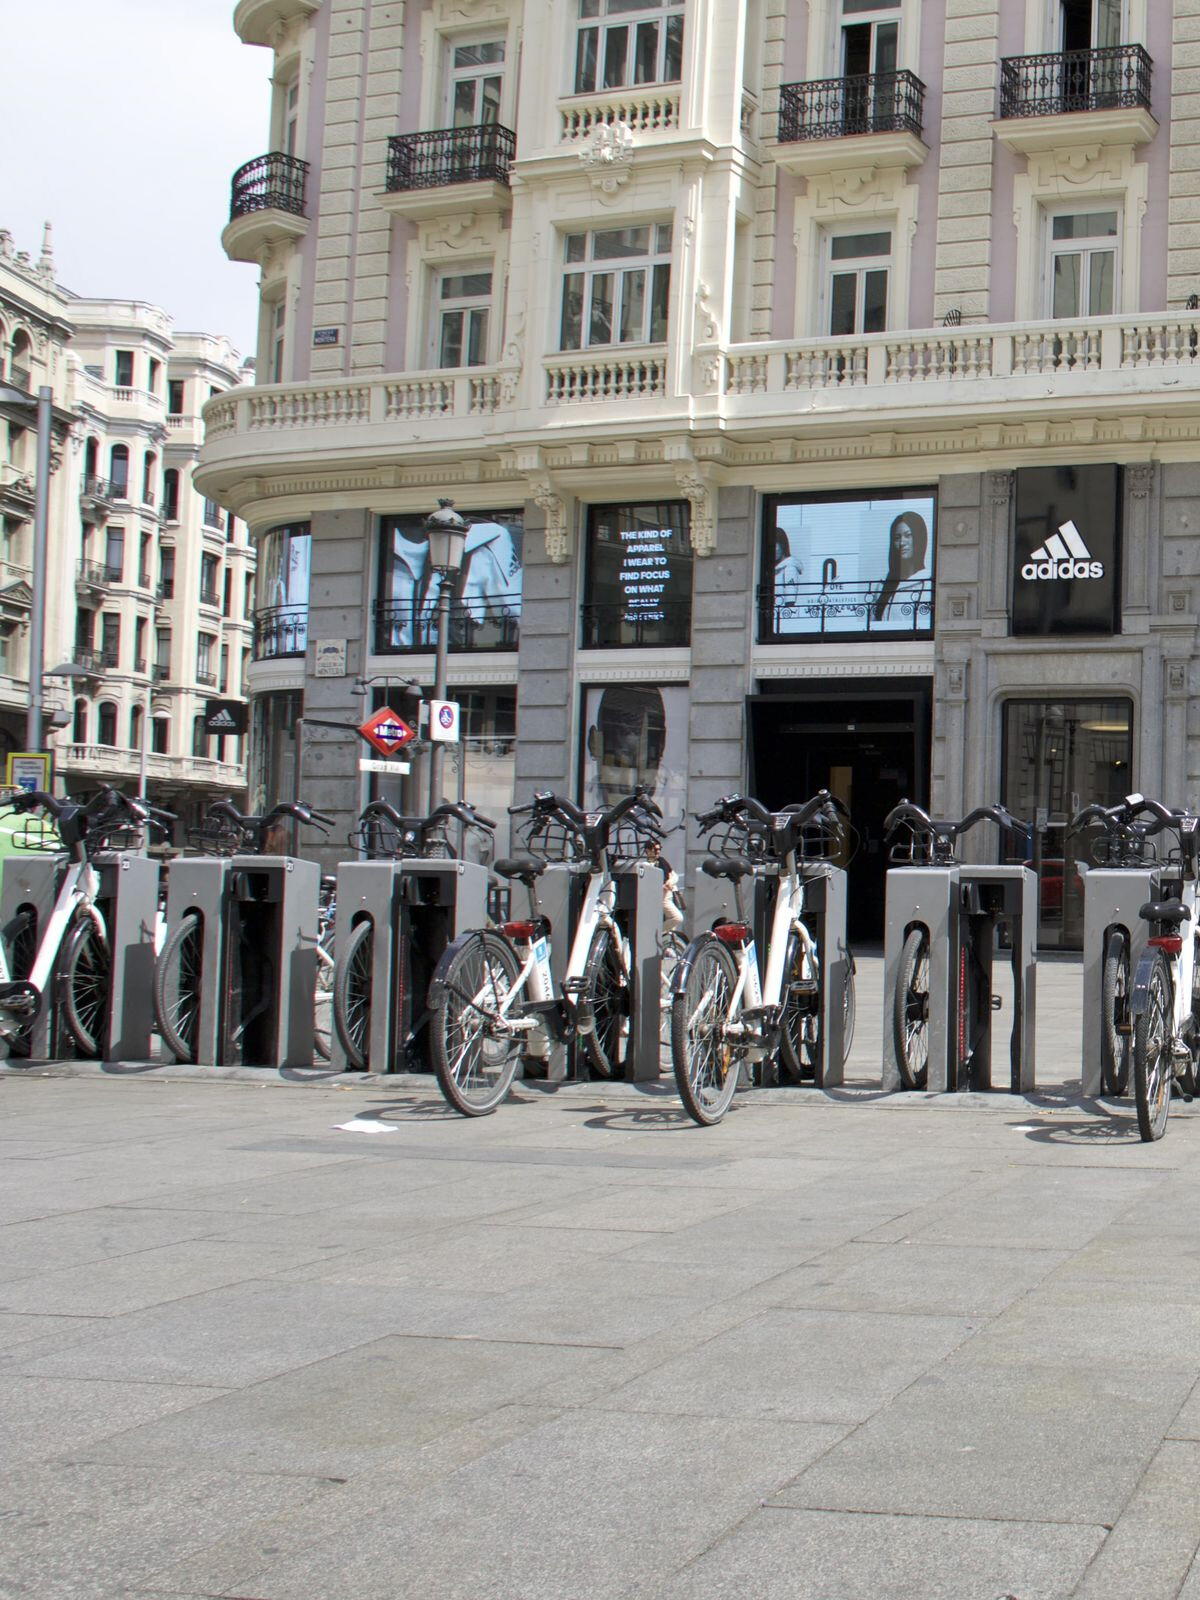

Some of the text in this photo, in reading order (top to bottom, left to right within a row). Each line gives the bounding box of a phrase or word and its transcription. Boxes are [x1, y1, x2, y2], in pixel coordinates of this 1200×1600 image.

[620, 529, 673, 540] THE KIND OF
[627, 543, 665, 553] APPAREL
[623, 556, 667, 567] I WEAR TO
[1021, 557, 1104, 580] adidas
[620, 570, 671, 581] FIND FOCUS
[624, 584, 665, 594] ON WHAT
[379, 725, 403, 737] Metro
